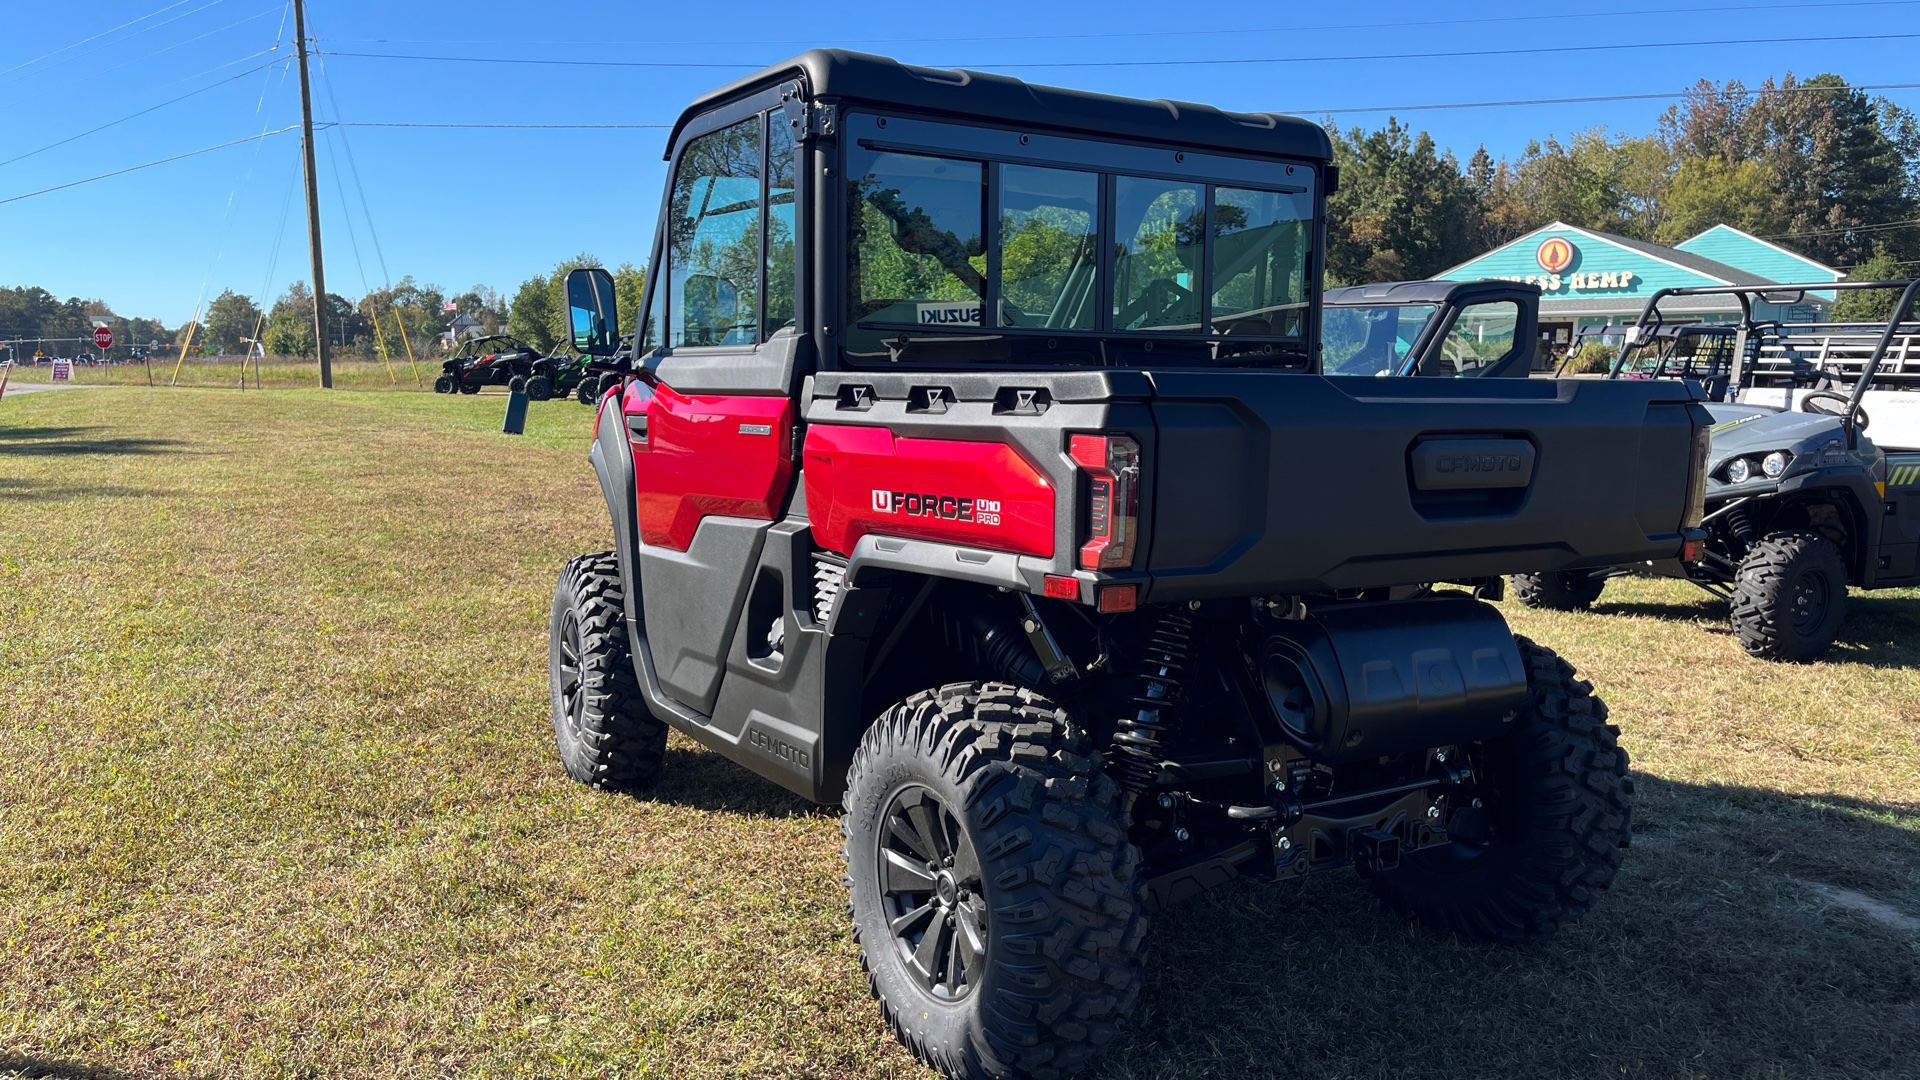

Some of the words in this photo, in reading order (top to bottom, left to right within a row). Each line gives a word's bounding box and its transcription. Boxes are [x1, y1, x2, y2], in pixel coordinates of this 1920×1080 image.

[1569, 271, 1634, 289] HEMP
[95, 333, 112, 342] STOP
[1436, 454, 1522, 473] CFMOTO
[976, 498, 1001, 512] U10
[976, 513, 1001, 526] PRO
[749, 727, 809, 771] CFMOTO
